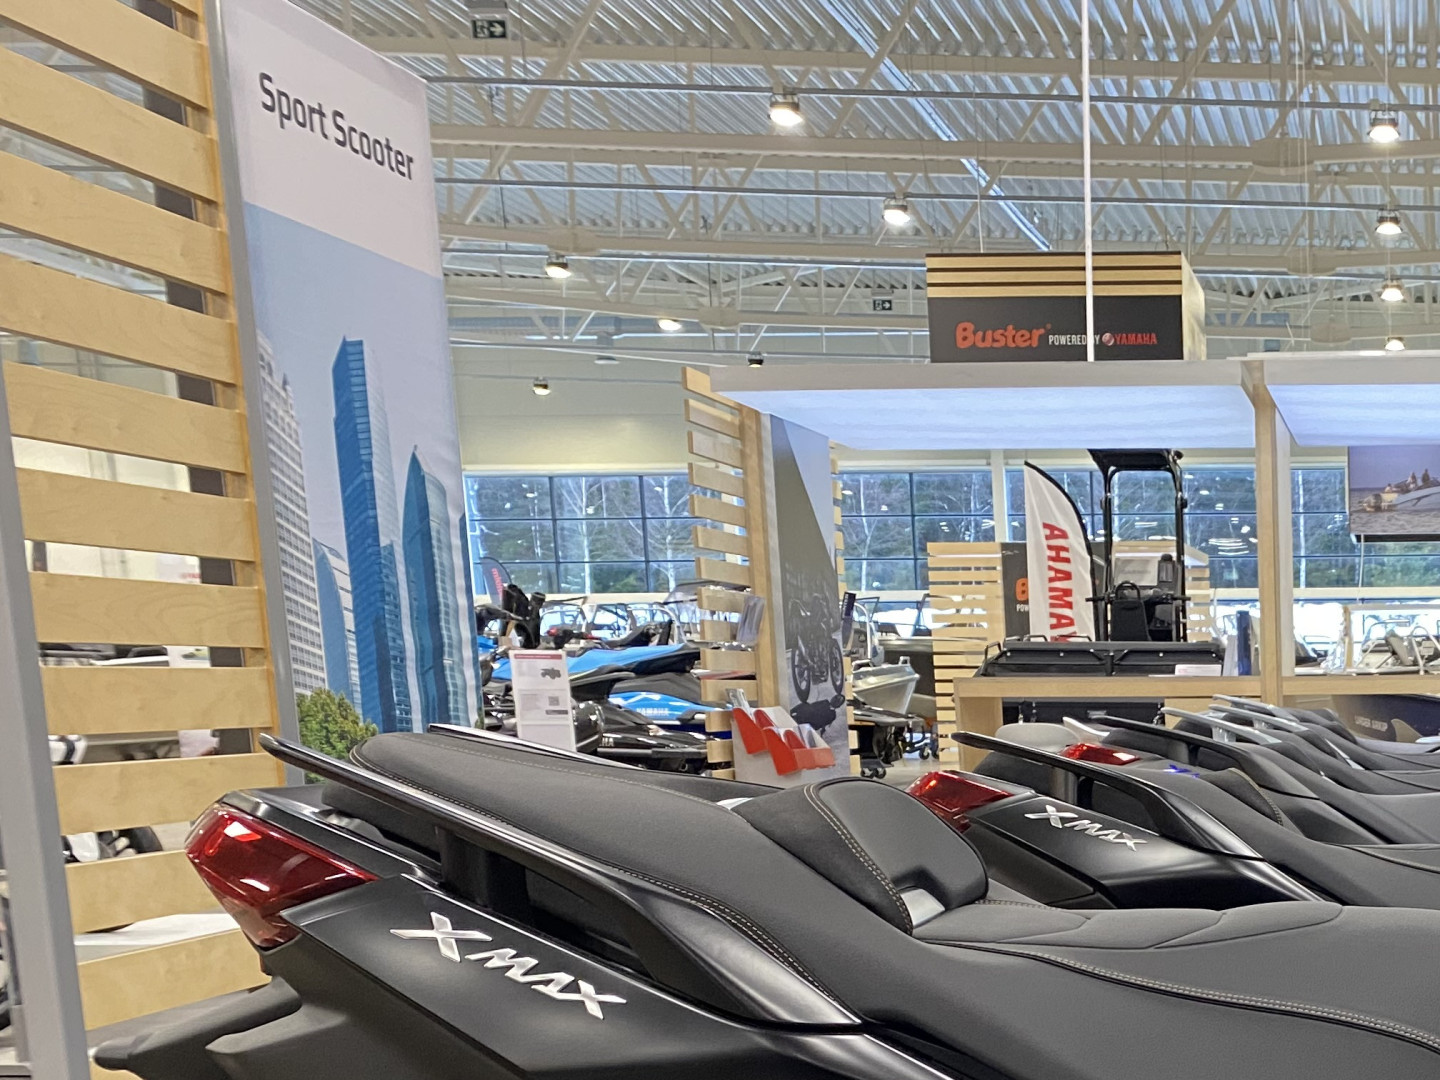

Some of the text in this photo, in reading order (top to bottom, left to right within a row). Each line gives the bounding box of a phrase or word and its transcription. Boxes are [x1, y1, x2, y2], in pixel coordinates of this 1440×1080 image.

[259, 72, 413, 180] Sport Scooter
[956, 321, 1045, 348] Buster
[1049, 334, 1087, 345] POWERED
[1115, 332, 1158, 345] YAMAHA
